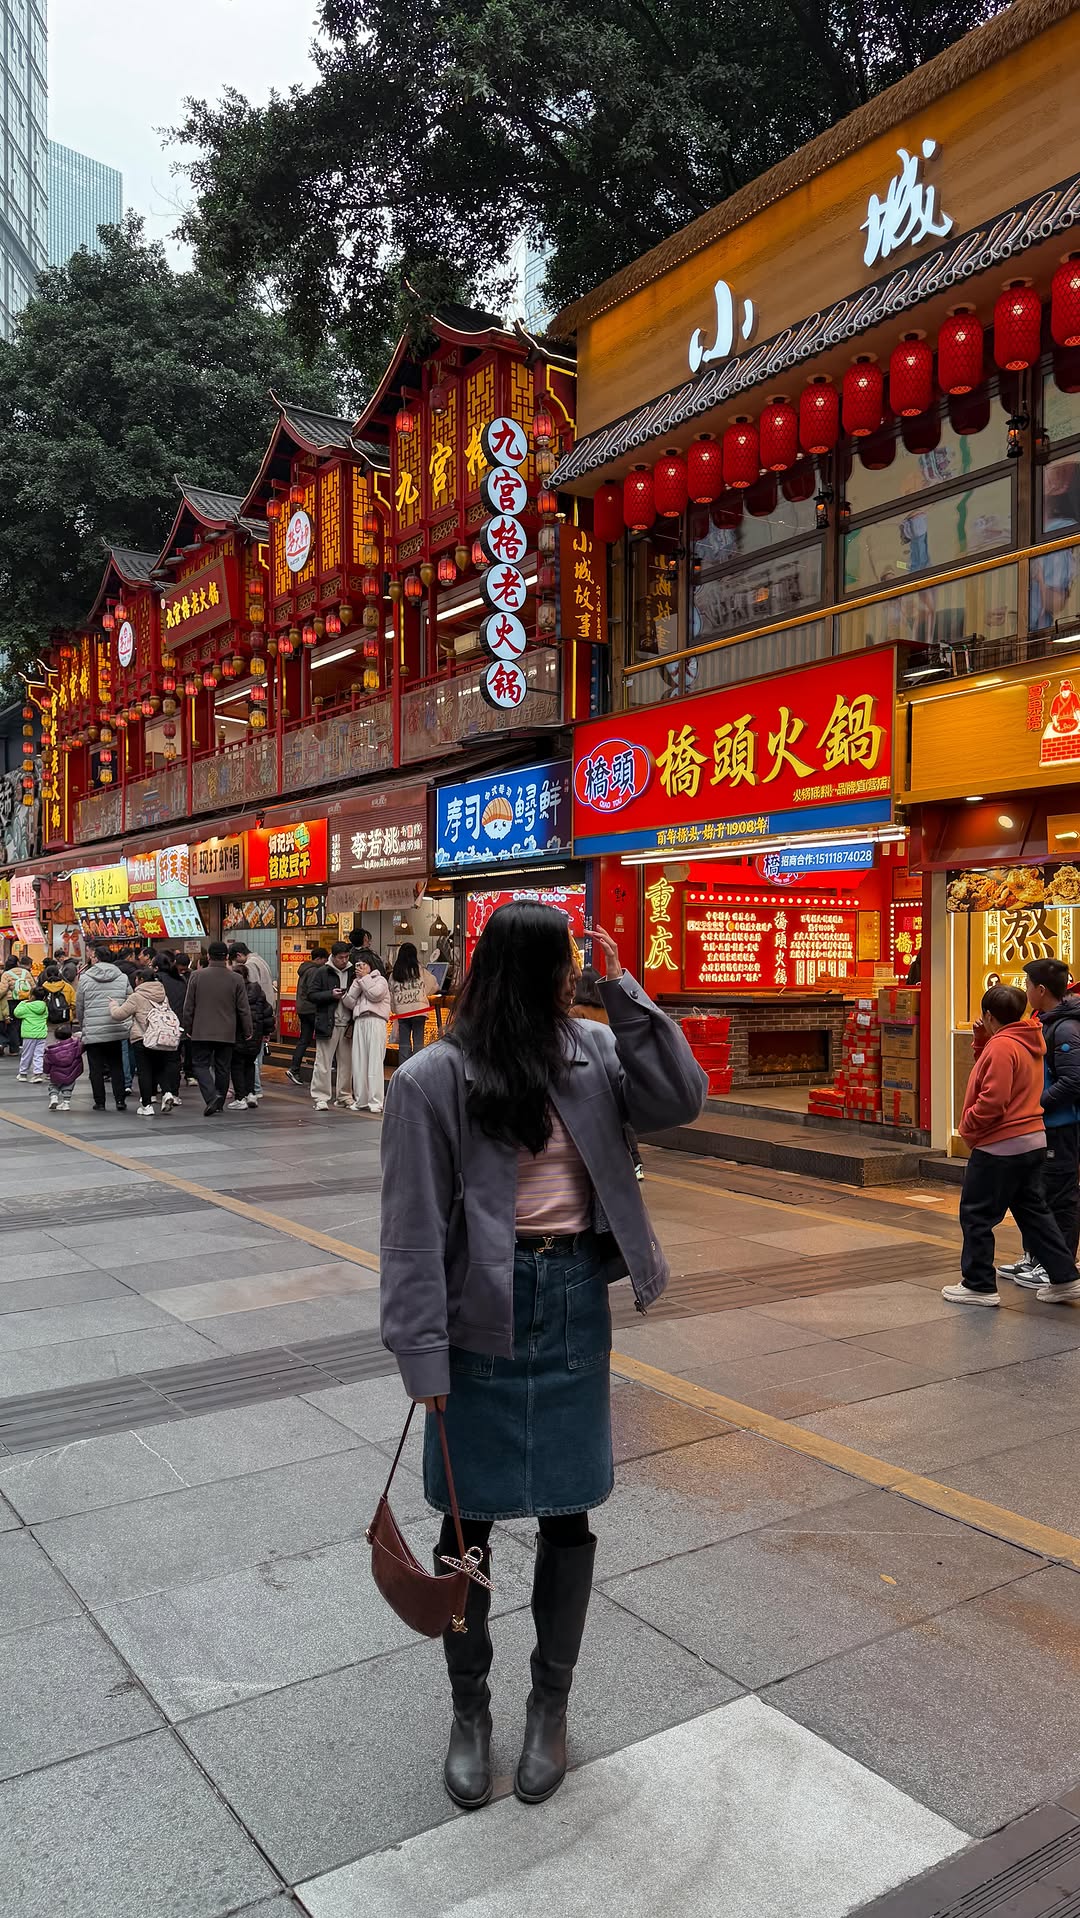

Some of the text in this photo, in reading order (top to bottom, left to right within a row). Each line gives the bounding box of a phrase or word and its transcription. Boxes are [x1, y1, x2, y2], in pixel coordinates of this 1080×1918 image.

[688, 138, 953, 373] 小城
[487, 420, 526, 705] 九宫格老火锅
[573, 530, 595, 638] 小城故事
[166, 581, 219, 629] 九宫格老火锅
[584, 749, 636, 802] 橋頭
[655, 694, 884, 798] 橋頭火鍋
[444, 794, 481, 843] 寿司
[268, 851, 311, 881] 苕皮豆干
[780, 850, 873, 867] 招商合作:15111874028
[644, 877, 679, 970] 重庆
